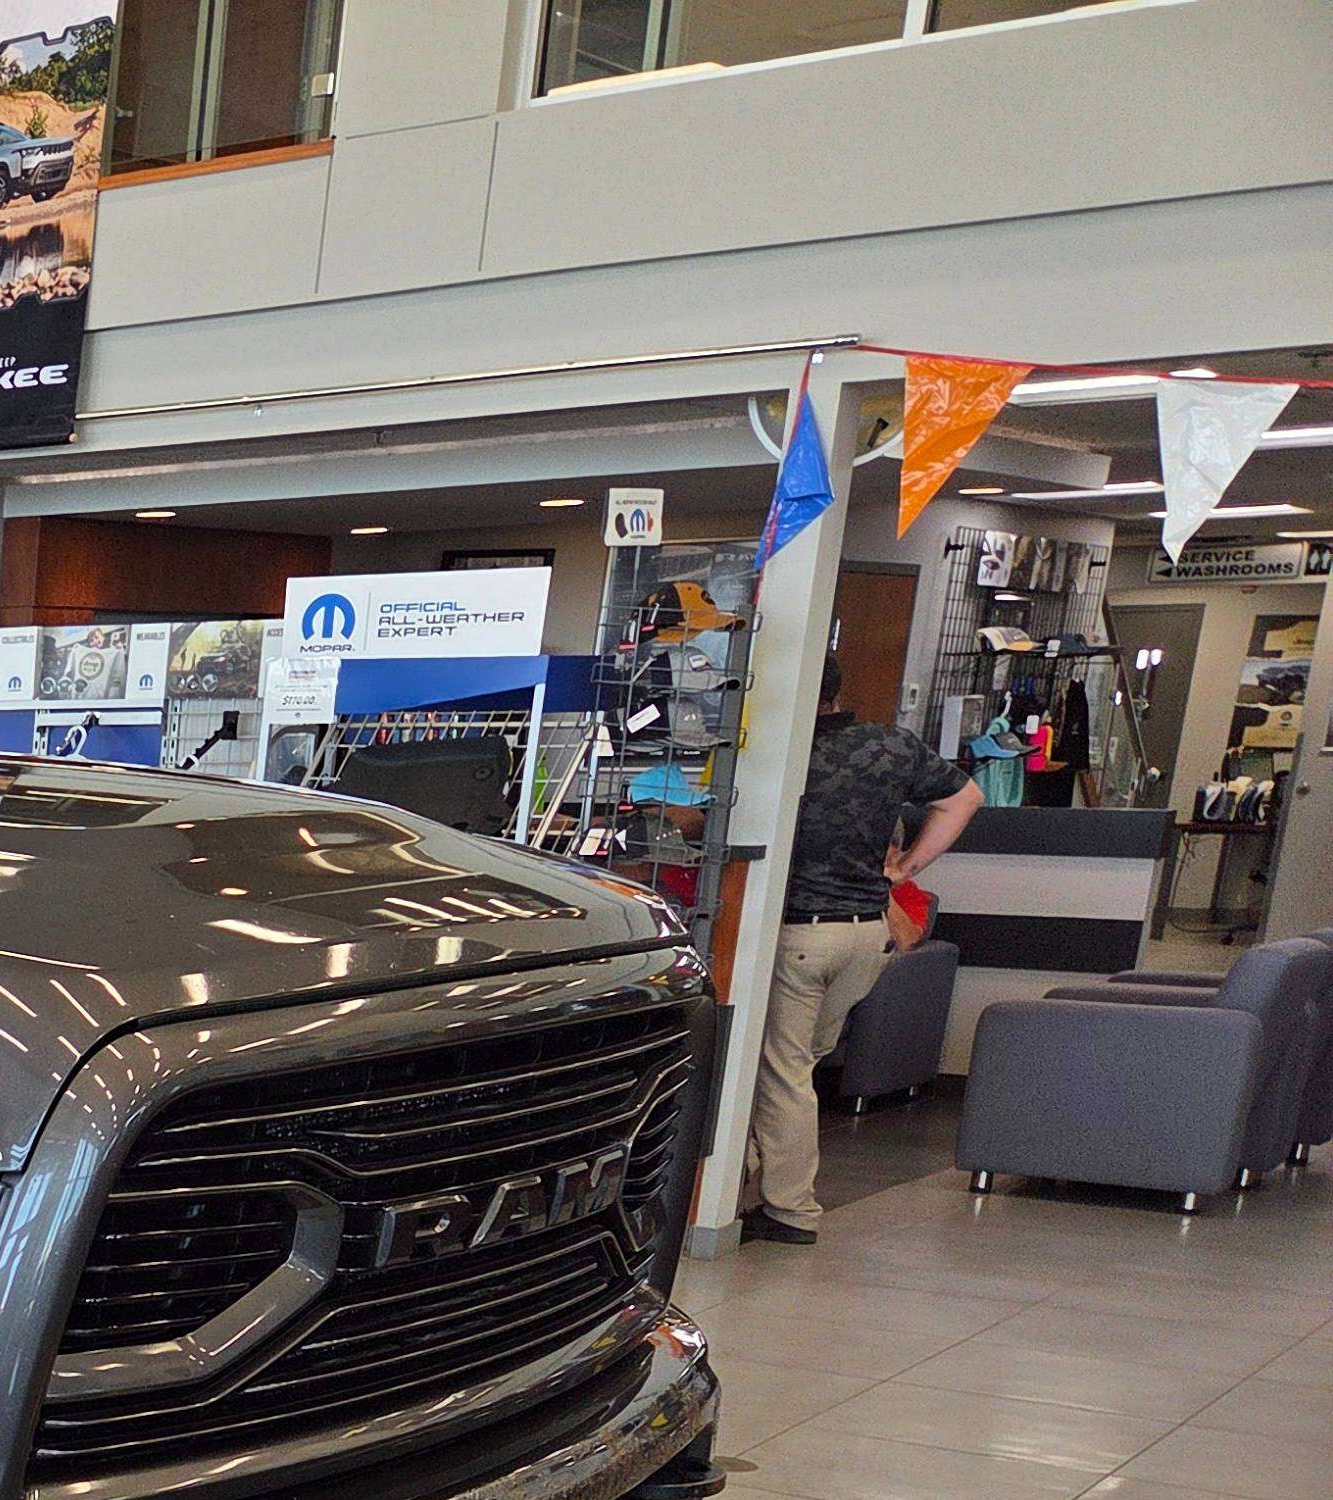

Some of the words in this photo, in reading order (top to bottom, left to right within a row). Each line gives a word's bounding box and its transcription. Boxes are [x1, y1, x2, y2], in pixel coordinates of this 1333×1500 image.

[1180, 549, 1255, 564] SERVICE
[1176, 562, 1294, 577] WASHROOMS
[379, 601, 467, 614] OFFICIAL
[378, 611, 525, 626] ALL-WEATHER
[377, 625, 458, 638] EXPERT
[299, 644, 353, 654] MOPAR
[375, 1148, 625, 1268] RAM
